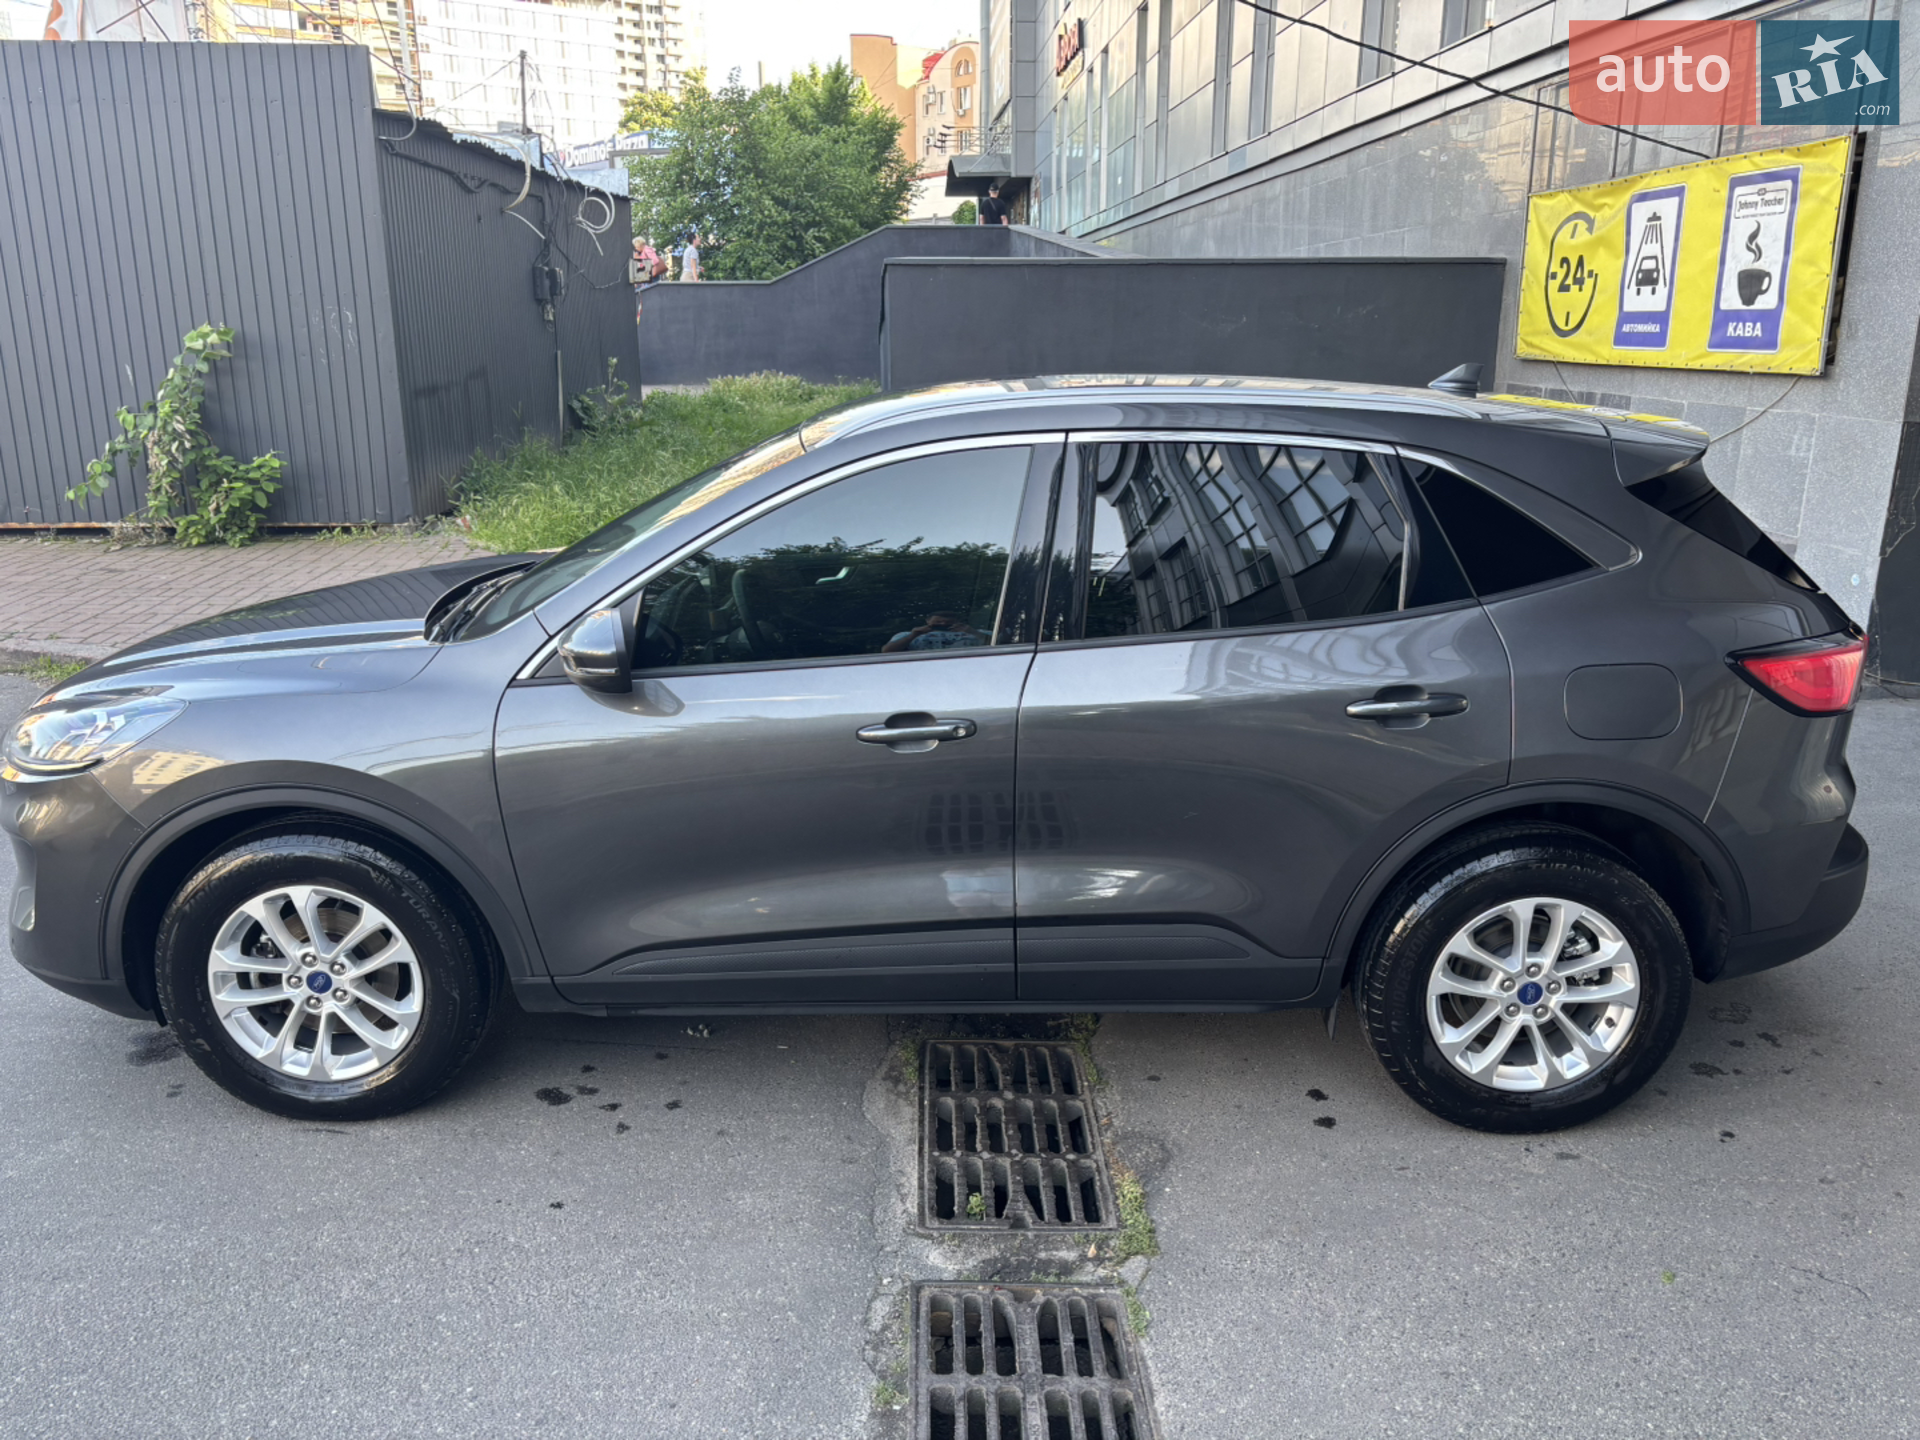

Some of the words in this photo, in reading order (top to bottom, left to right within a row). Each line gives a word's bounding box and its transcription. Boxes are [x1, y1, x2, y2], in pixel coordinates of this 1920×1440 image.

[1737, 200, 1759, 212] Johnny
[1760, 196, 1784, 206] Teacher
[1557, 254, 1585, 292] 24
[1621, 322, 1661, 333] АВТОМИЙКА
[1726, 322, 1762, 337] КАВА
[400, 887, 455, 966] TURANZA
